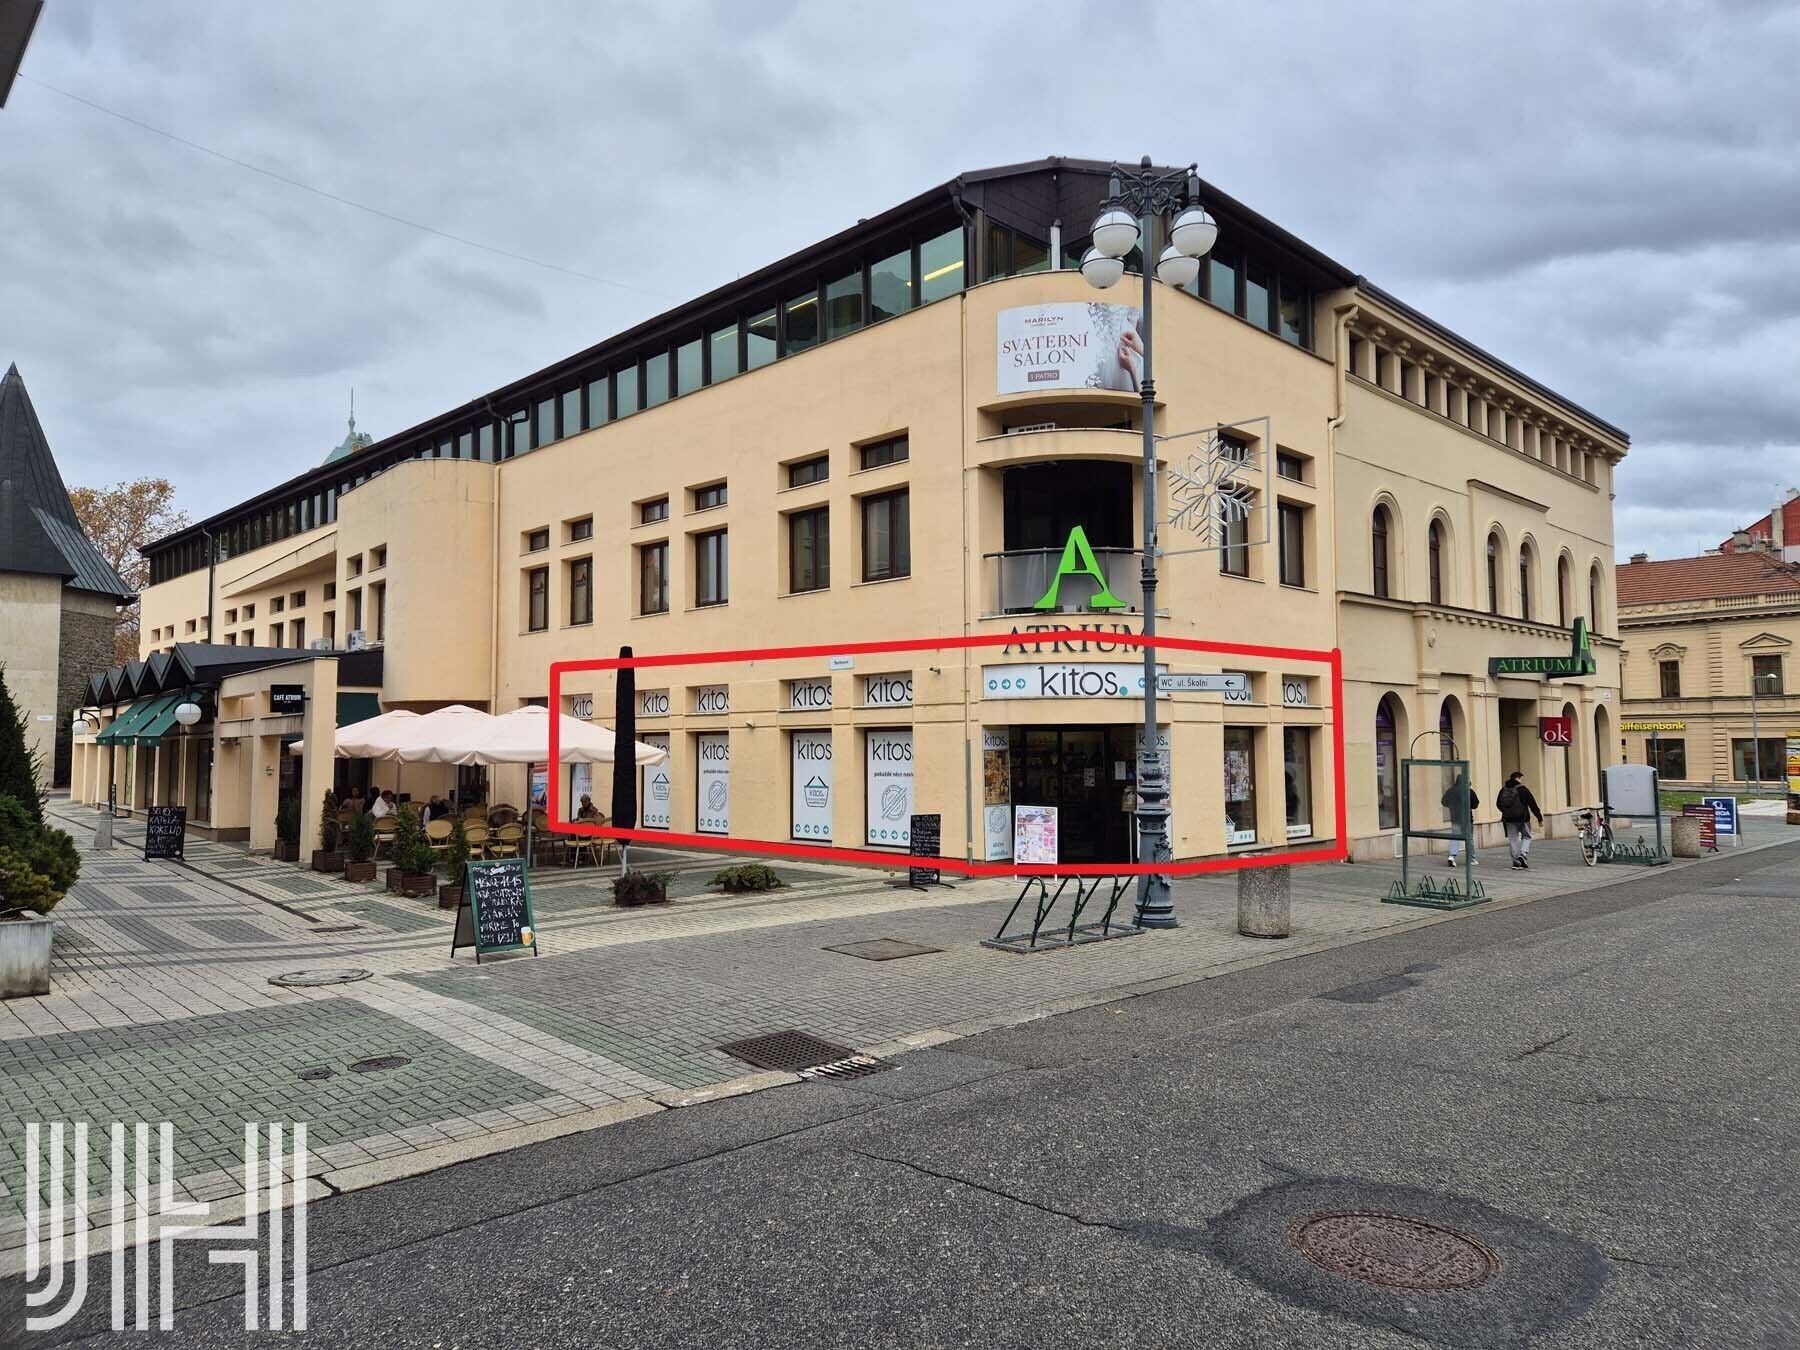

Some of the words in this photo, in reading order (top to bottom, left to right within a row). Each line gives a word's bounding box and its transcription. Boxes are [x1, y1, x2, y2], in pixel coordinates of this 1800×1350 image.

[1025, 316, 1063, 324] MARILYN
[1003, 331, 1088, 354] SVATEBNÍ
[1014, 349, 1075, 367] SALON
[1034, 525, 1127, 609] A
[1498, 659, 1572, 672] ATRIUM
[1161, 679, 1173, 688] WC
[1543, 722, 1569, 743] ok
